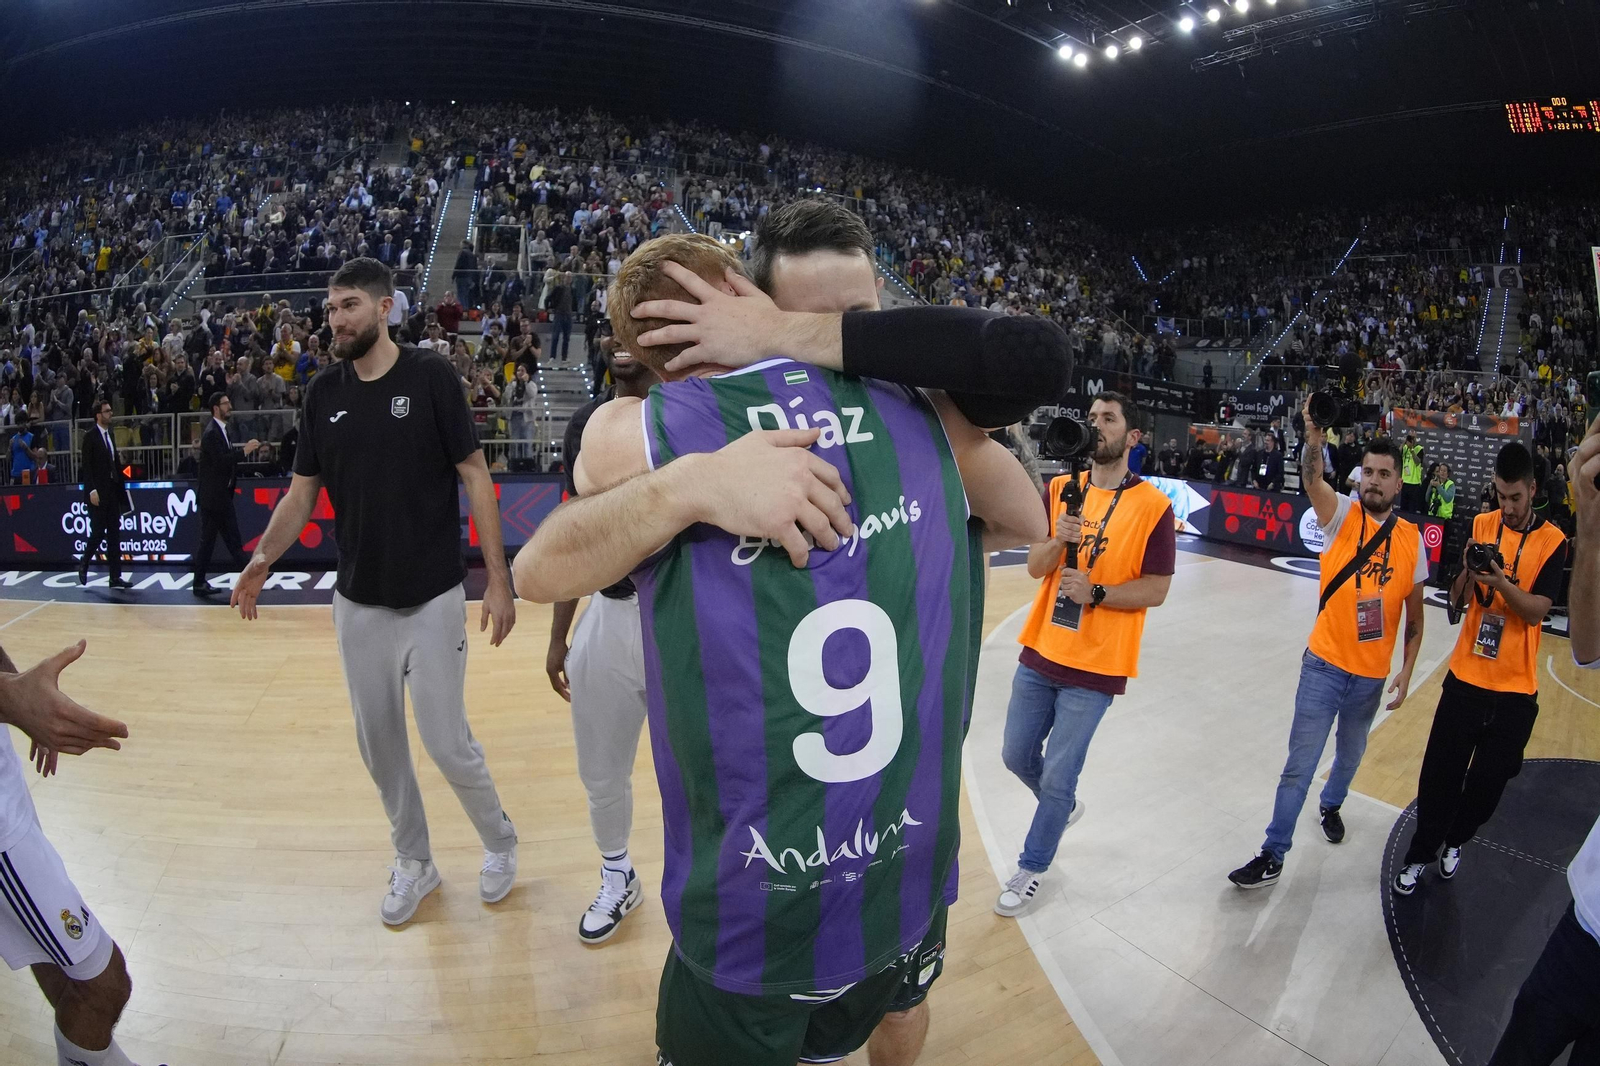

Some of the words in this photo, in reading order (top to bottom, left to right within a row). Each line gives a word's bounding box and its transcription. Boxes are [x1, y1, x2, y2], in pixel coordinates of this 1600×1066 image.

[746, 396, 874, 449] Díaz
[71, 501, 89, 516] ac
[140, 511, 179, 538] Rey
[142, 539, 168, 552] 2025
[1481, 637, 1497, 647] AAA
[787, 598, 904, 784] 9
